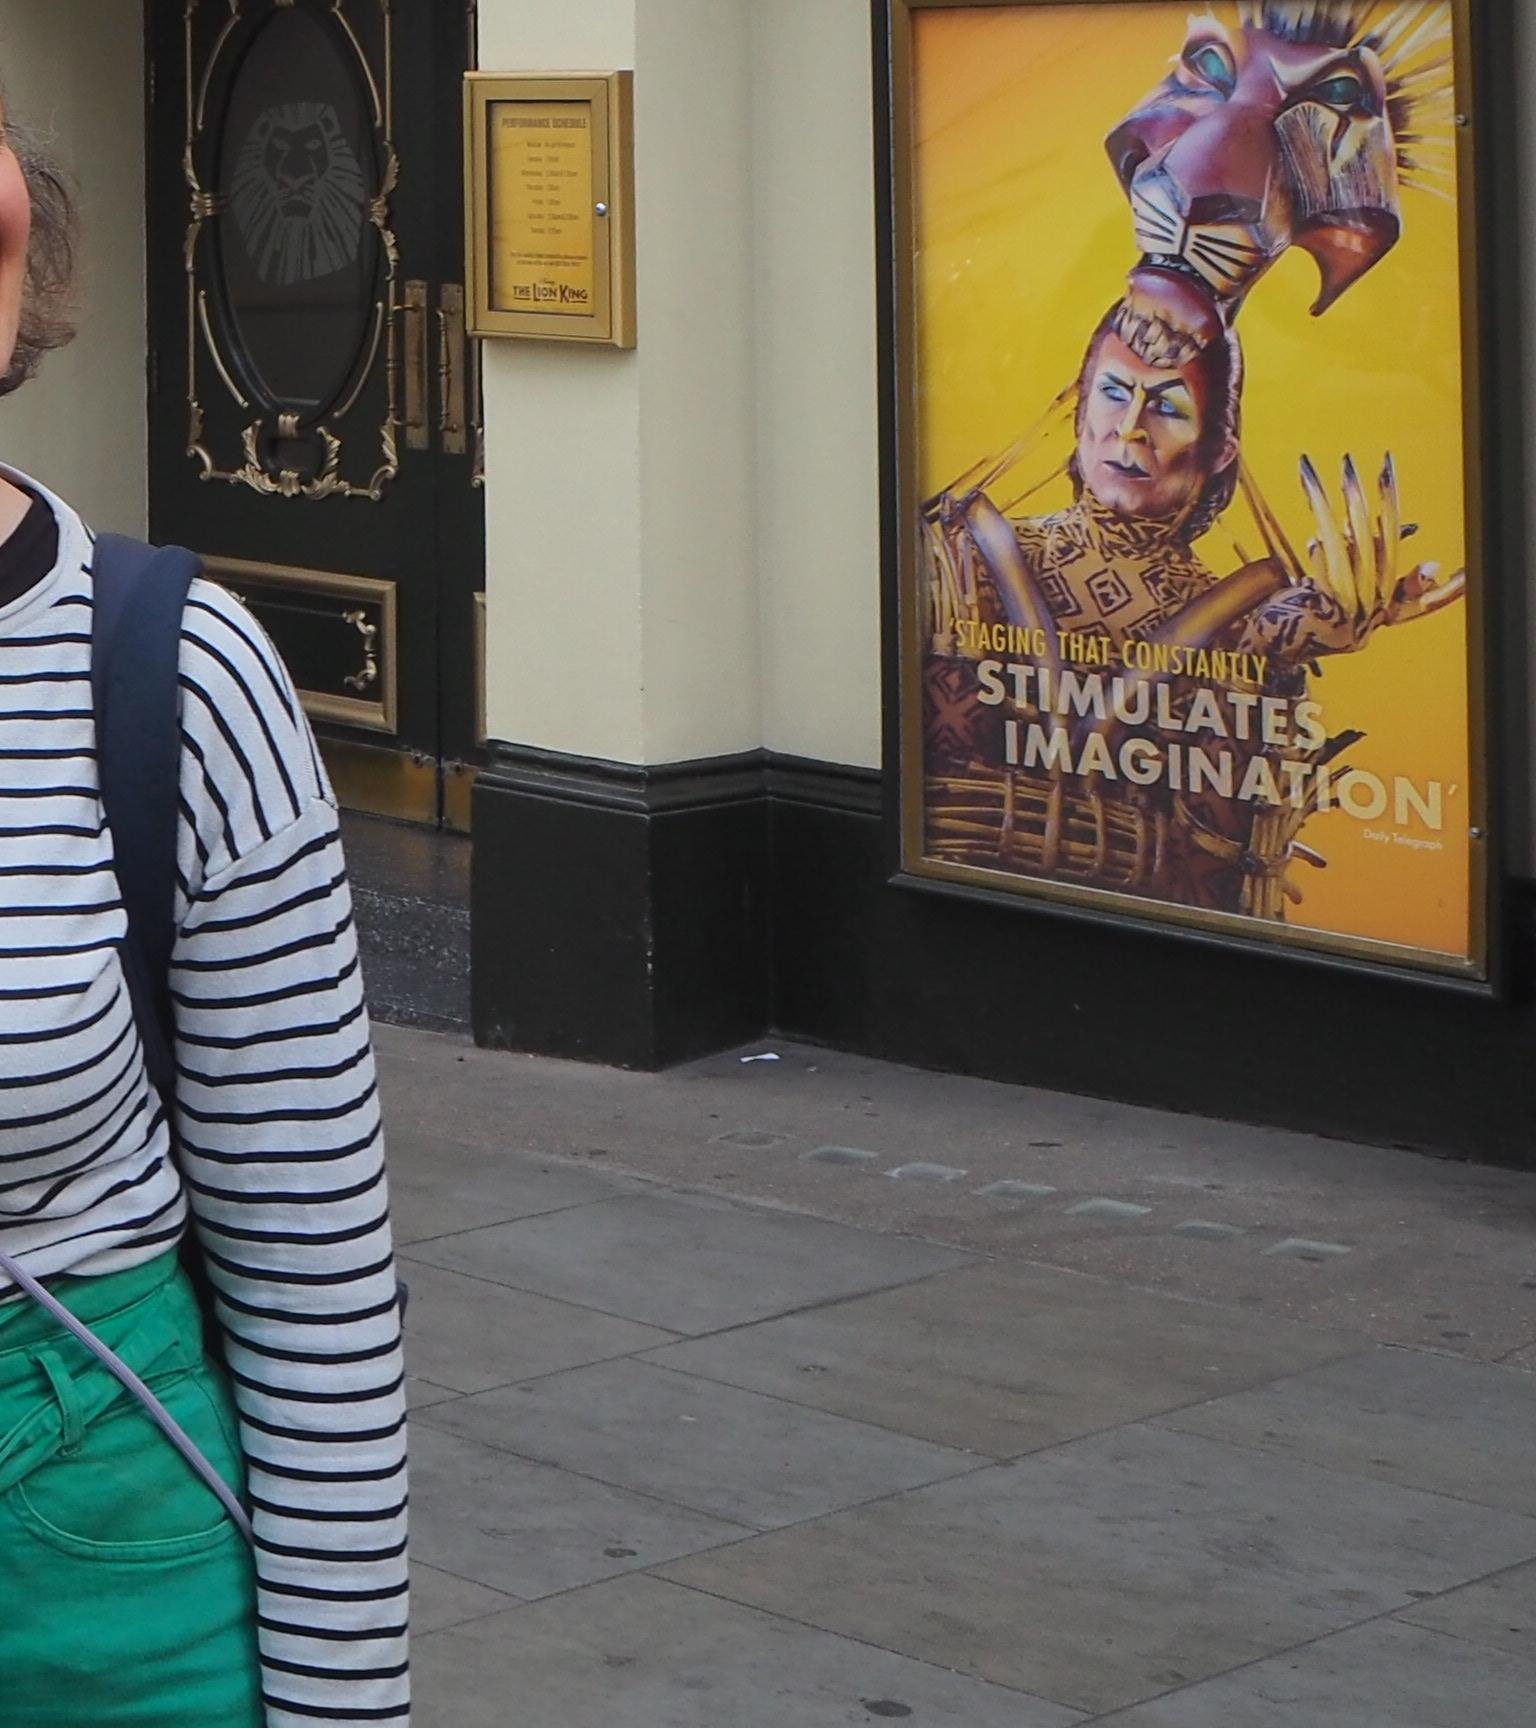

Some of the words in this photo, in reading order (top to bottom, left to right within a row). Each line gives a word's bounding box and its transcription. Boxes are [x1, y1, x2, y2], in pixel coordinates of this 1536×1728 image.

[513, 285, 530, 297] THE
[533, 283, 557, 302] LION
[559, 284, 588, 303] KING
[1056, 630, 1112, 666] THAT
[1122, 640, 1269, 686] CONSTANTLY
[975, 659, 1329, 752] STIMULATES
